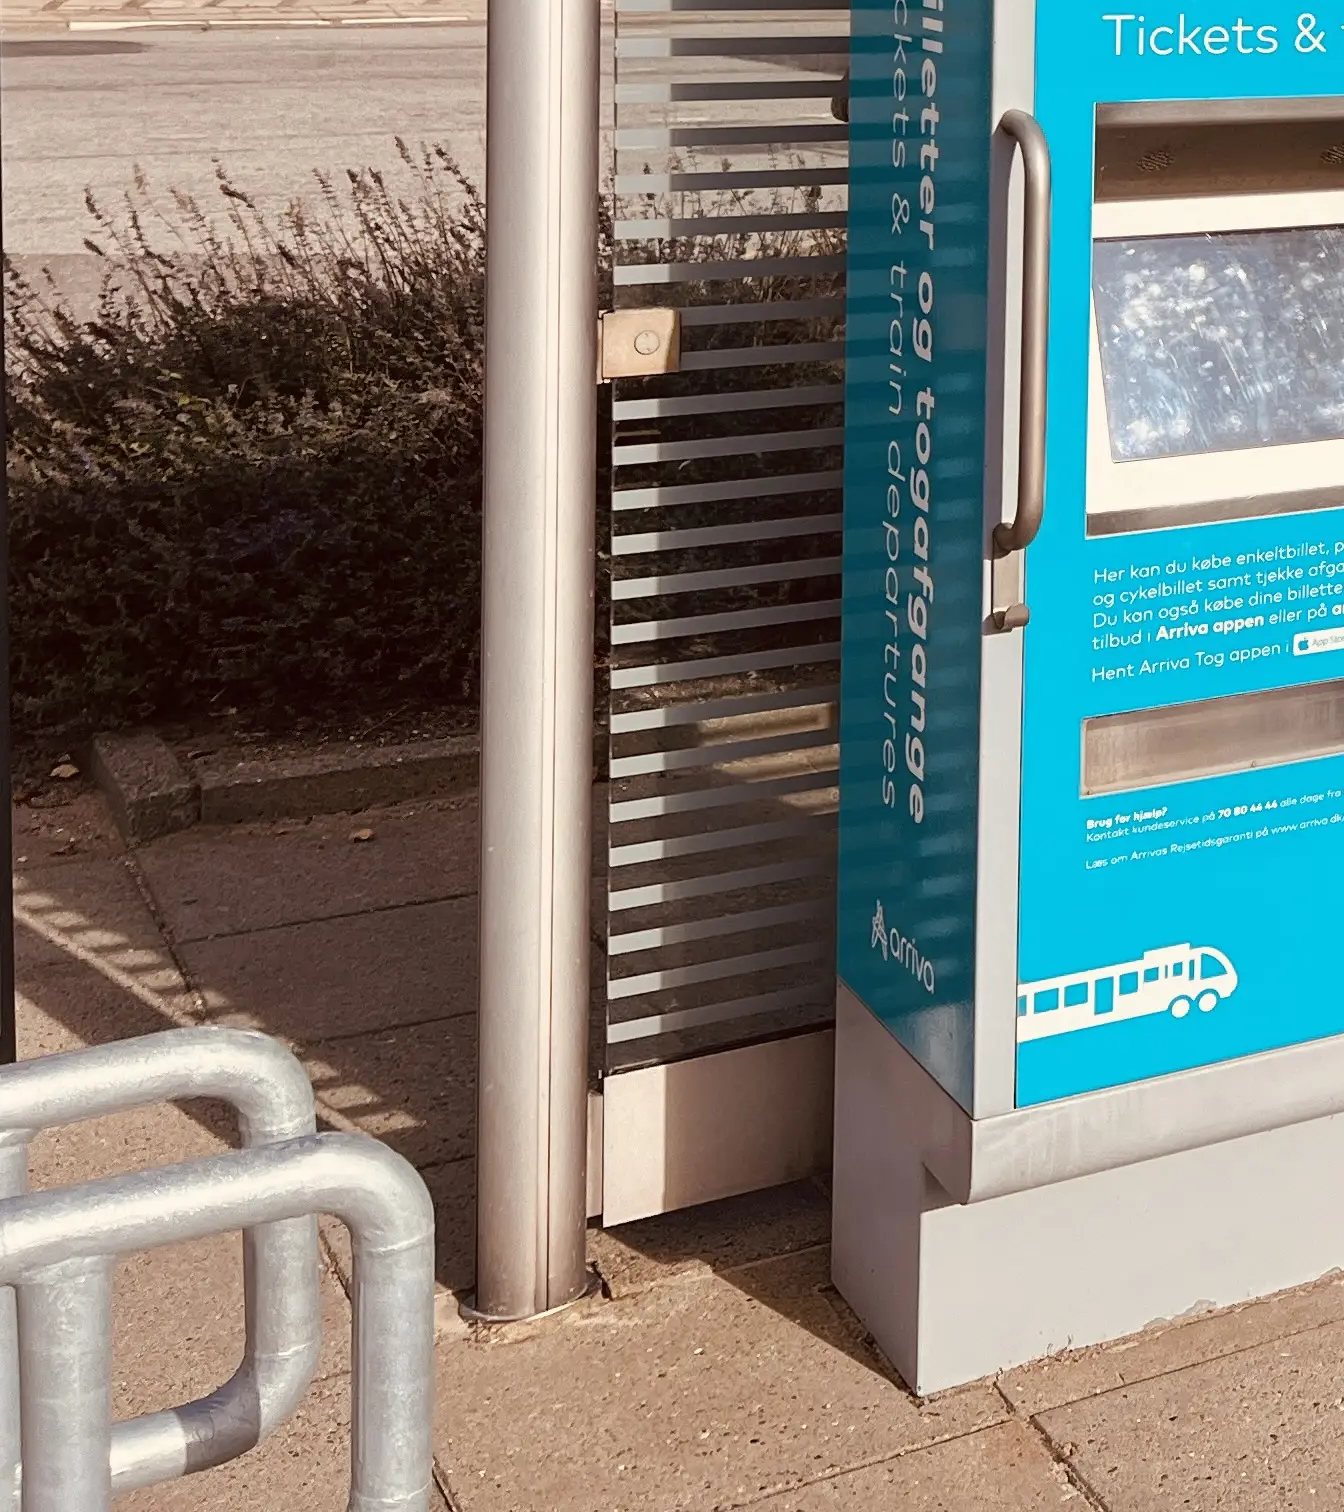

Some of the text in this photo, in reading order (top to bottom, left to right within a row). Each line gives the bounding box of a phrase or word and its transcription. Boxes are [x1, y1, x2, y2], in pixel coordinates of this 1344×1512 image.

[1102, 12, 1279, 56] Tickets
[1294, 12, 1328, 53] &
[890, 192, 910, 236] &
[886, 260, 908, 415] train
[912, 271, 934, 363] og
[1094, 567, 1125, 585] Her
[1130, 563, 1161, 579] kan
[1165, 560, 1187, 575] du
[1192, 554, 1231, 572] købe
[1236, 542, 1330, 567] enkeltbillet,
[905, 386, 936, 825] togafgange
[1093, 591, 1115, 608] og
[1120, 578, 1203, 604] cykelbillet
[1207, 573, 1252, 592] samt
[1256, 565, 1303, 587] tjekke
[881, 438, 905, 810] departures
[1092, 631, 1142, 650] tilbud
[1156, 620, 1209, 642] Arriva
[1213, 614, 1265, 638] appen
[1268, 608, 1302, 625] eller
[1307, 603, 1328, 622] på
[1094, 612, 1118, 629] Du
[1123, 608, 1153, 624] kan
[1158, 602, 1199, 623] også
[1204, 595, 1244, 613] købe
[1248, 590, 1283, 607] dine
[1092, 664, 1135, 683] Hent
[1139, 656, 1190, 675] Arriva
[1195, 649, 1225, 667] Tog
[1229, 644, 1281, 663] appen
[1086, 827, 1130, 843] Kontakt
[1132, 815, 1200, 834] kundeservice
[1202, 811, 1216, 823] på
[1218, 807, 1232, 819] 70
[1279, 797, 1297, 808] alle
[1299, 793, 1324, 805] dage
[1327, 789, 1342, 799] fra
[1086, 819, 1113, 830] Brug
[1085, 858, 1109, 870] Læs
[1111, 854, 1128, 865] om
[1130, 846, 1167, 861] Arrivas
[1170, 831, 1254, 854] Rejsetidsgaranti
[1255, 826, 1268, 839] på
[889, 922, 936, 995] arriva
